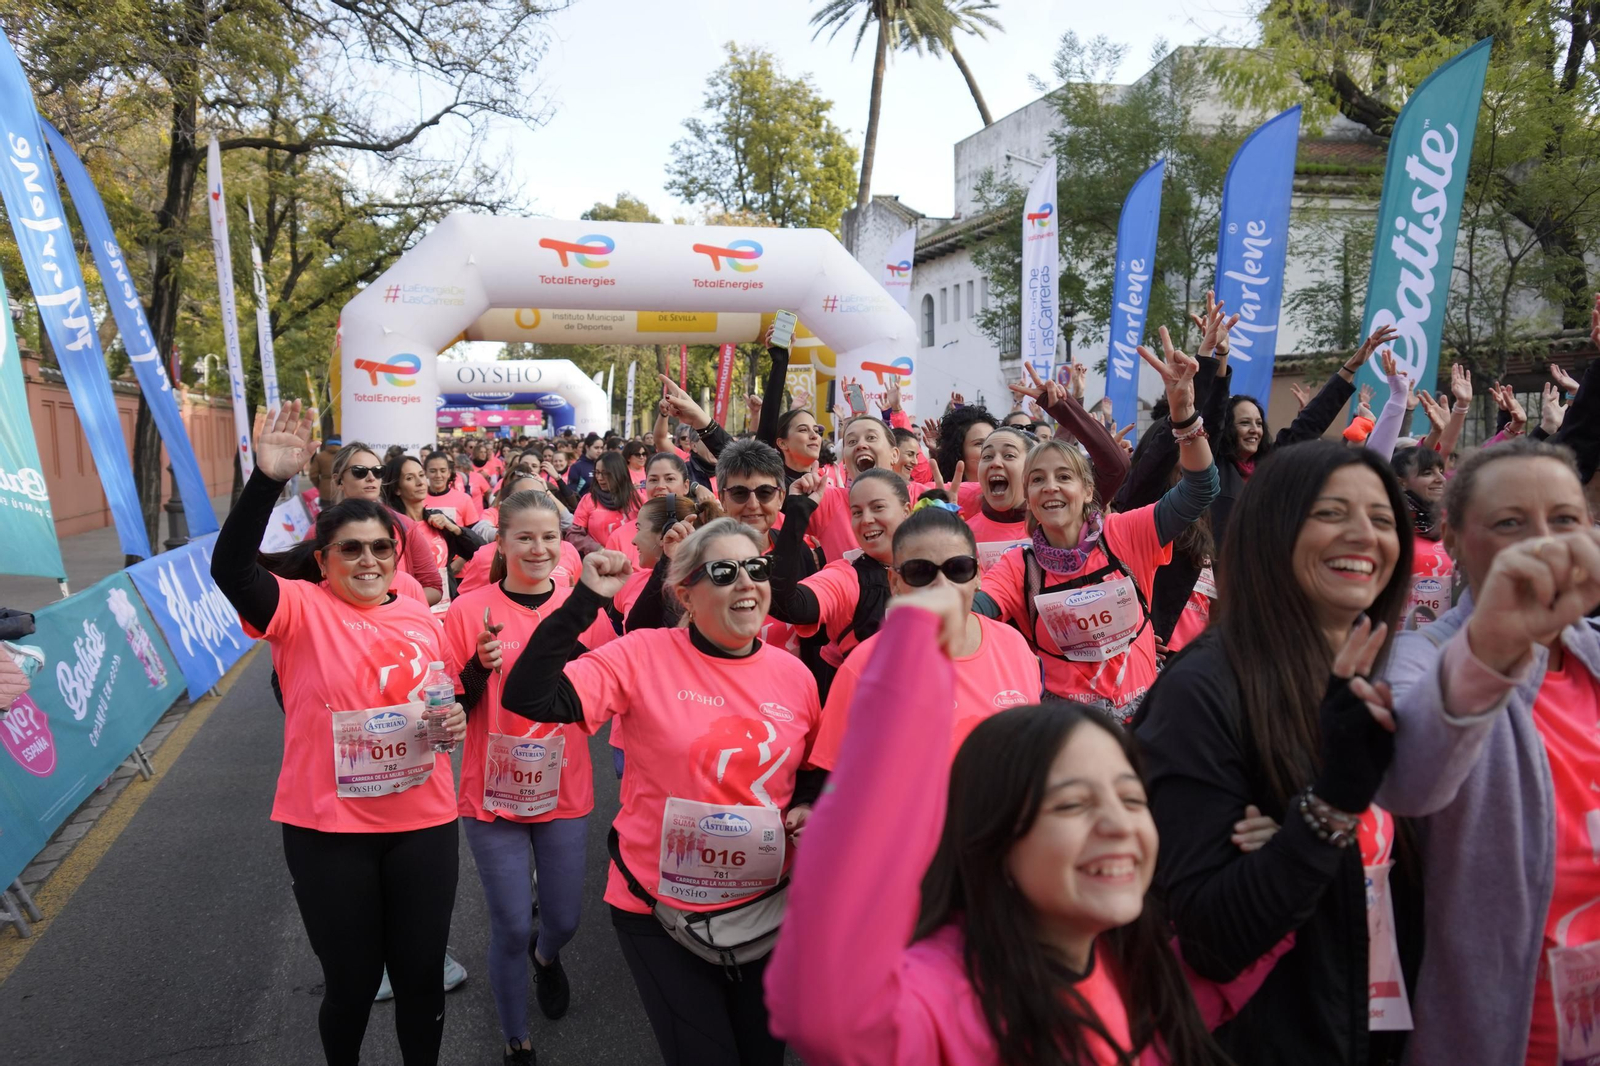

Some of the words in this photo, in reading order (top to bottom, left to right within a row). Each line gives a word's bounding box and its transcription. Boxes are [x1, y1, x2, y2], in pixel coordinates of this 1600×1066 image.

[1369, 122, 1460, 387] Batiste
[538, 274, 616, 287] TotalEnergies
[692, 278, 764, 291] TotalEnergies
[1221, 219, 1277, 362] Marlene
[552, 312, 584, 322] Instituto
[586, 313, 626, 323] Municipal
[1037, 265, 1054, 357] LasCarreras
[658, 314, 668, 322] DE
[1114, 257, 1150, 381] Marlene
[564, 323, 575, 331] de
[577, 324, 614, 334] Deportes
[457, 366, 542, 384] OYSHO
[717, 343, 732, 400] Santander
[353, 393, 422, 405] TotalEnergies
[1068, 591, 1104, 605] ASTURIANA
[158, 552, 242, 677] Marlen
[1045, 603, 1064, 613] SUMA
[1076, 610, 1113, 631] 016
[1092, 631, 1106, 641] 608
[498, 641, 520, 651] SHO
[1111, 641, 1130, 652] Santan
[56, 618, 106, 721] Batiste
[677, 689, 725, 708] OYSHO
[367, 720, 405, 731] ASTURIANA
[22, 736, 50, 763] ESPAÑA
[371, 742, 407, 760] 016
[384, 763, 398, 772] 782
[351, 775, 374, 783] CARRERA
[513, 770, 543, 784] 016
[349, 784, 382, 793] OYSHO
[519, 788, 536, 796] 6758
[492, 800, 519, 811] OYSHO
[673, 819, 696, 828] SUMA
[703, 819, 748, 832] ASTURIANA
[701, 848, 747, 866] 016
[675, 875, 701, 885] CARRERA
[713, 870, 729, 879] 781
[671, 885, 708, 899] OYSHO
